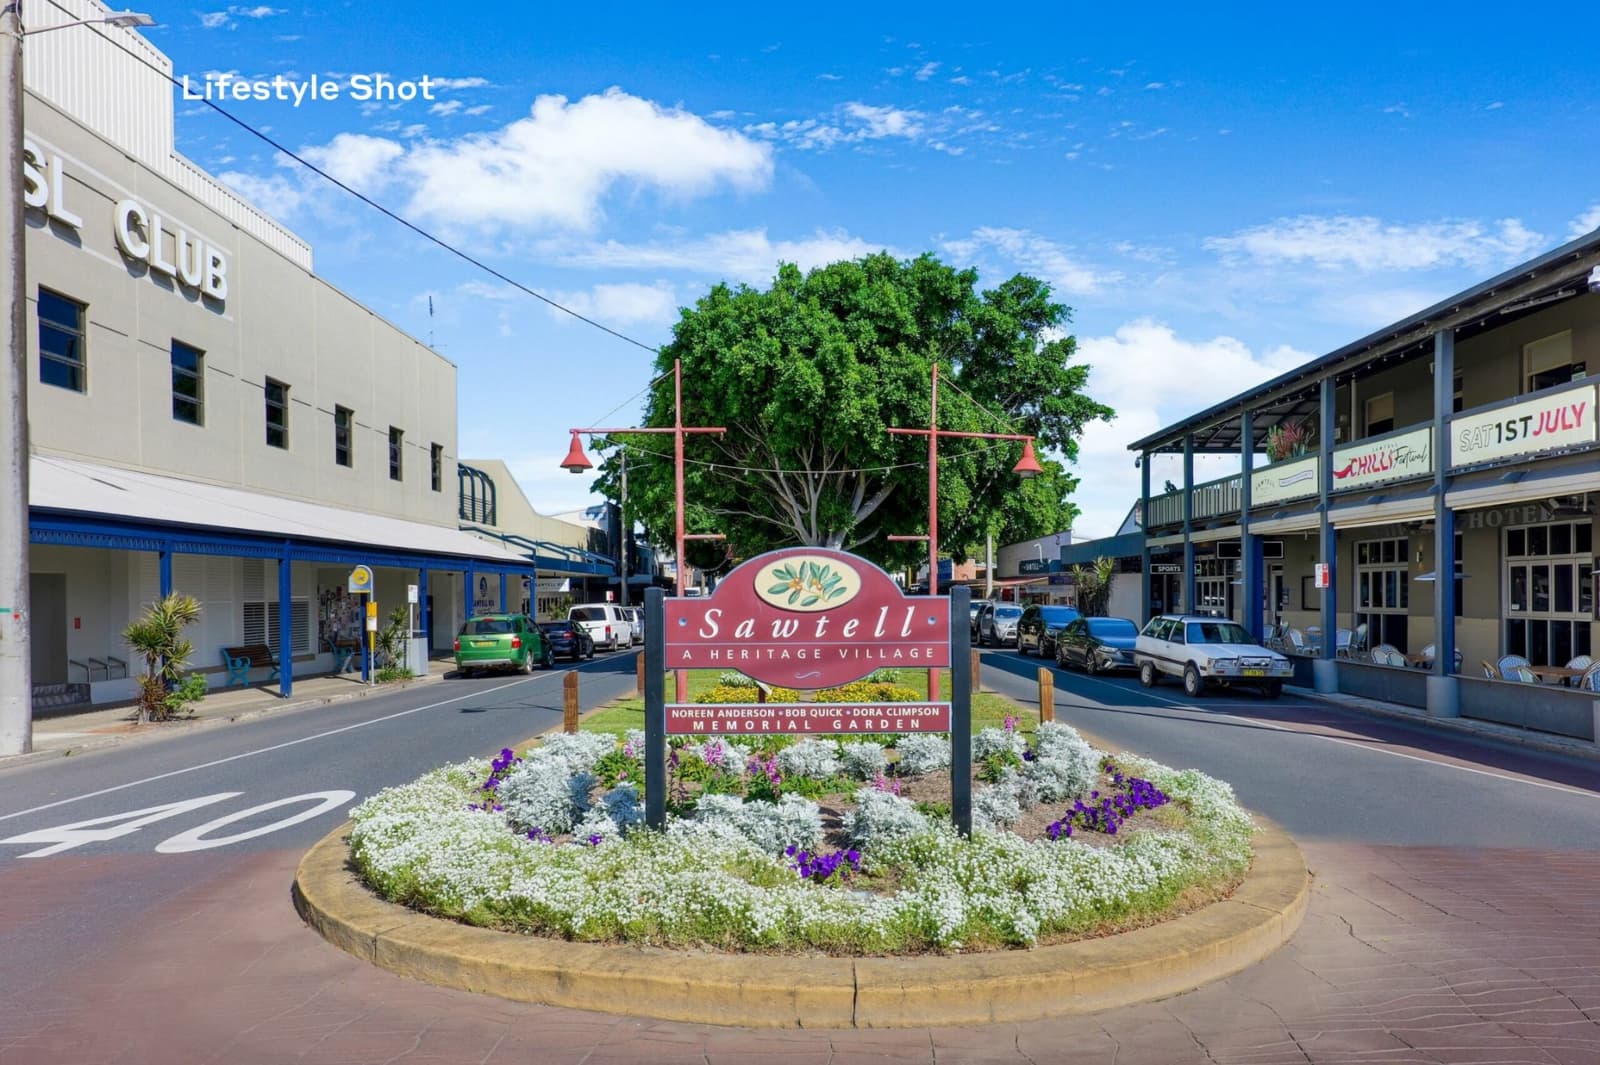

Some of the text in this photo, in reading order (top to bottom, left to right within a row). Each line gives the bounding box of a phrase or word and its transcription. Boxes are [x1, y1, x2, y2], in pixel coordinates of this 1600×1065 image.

[113, 200, 229, 301] CLUB
[1460, 401, 1586, 453] SAT 1ST JULY
[700, 606, 913, 638] Sawtell
[682, 648, 933, 660] A HERITAGE VILLAGE
[671, 707, 940, 718] NOREEN ANDERSON BOB QUICK DORA CLIMPSON
[693, 719, 920, 730] MEMORIAL GARDEN
[0, 790, 356, 859] 40
